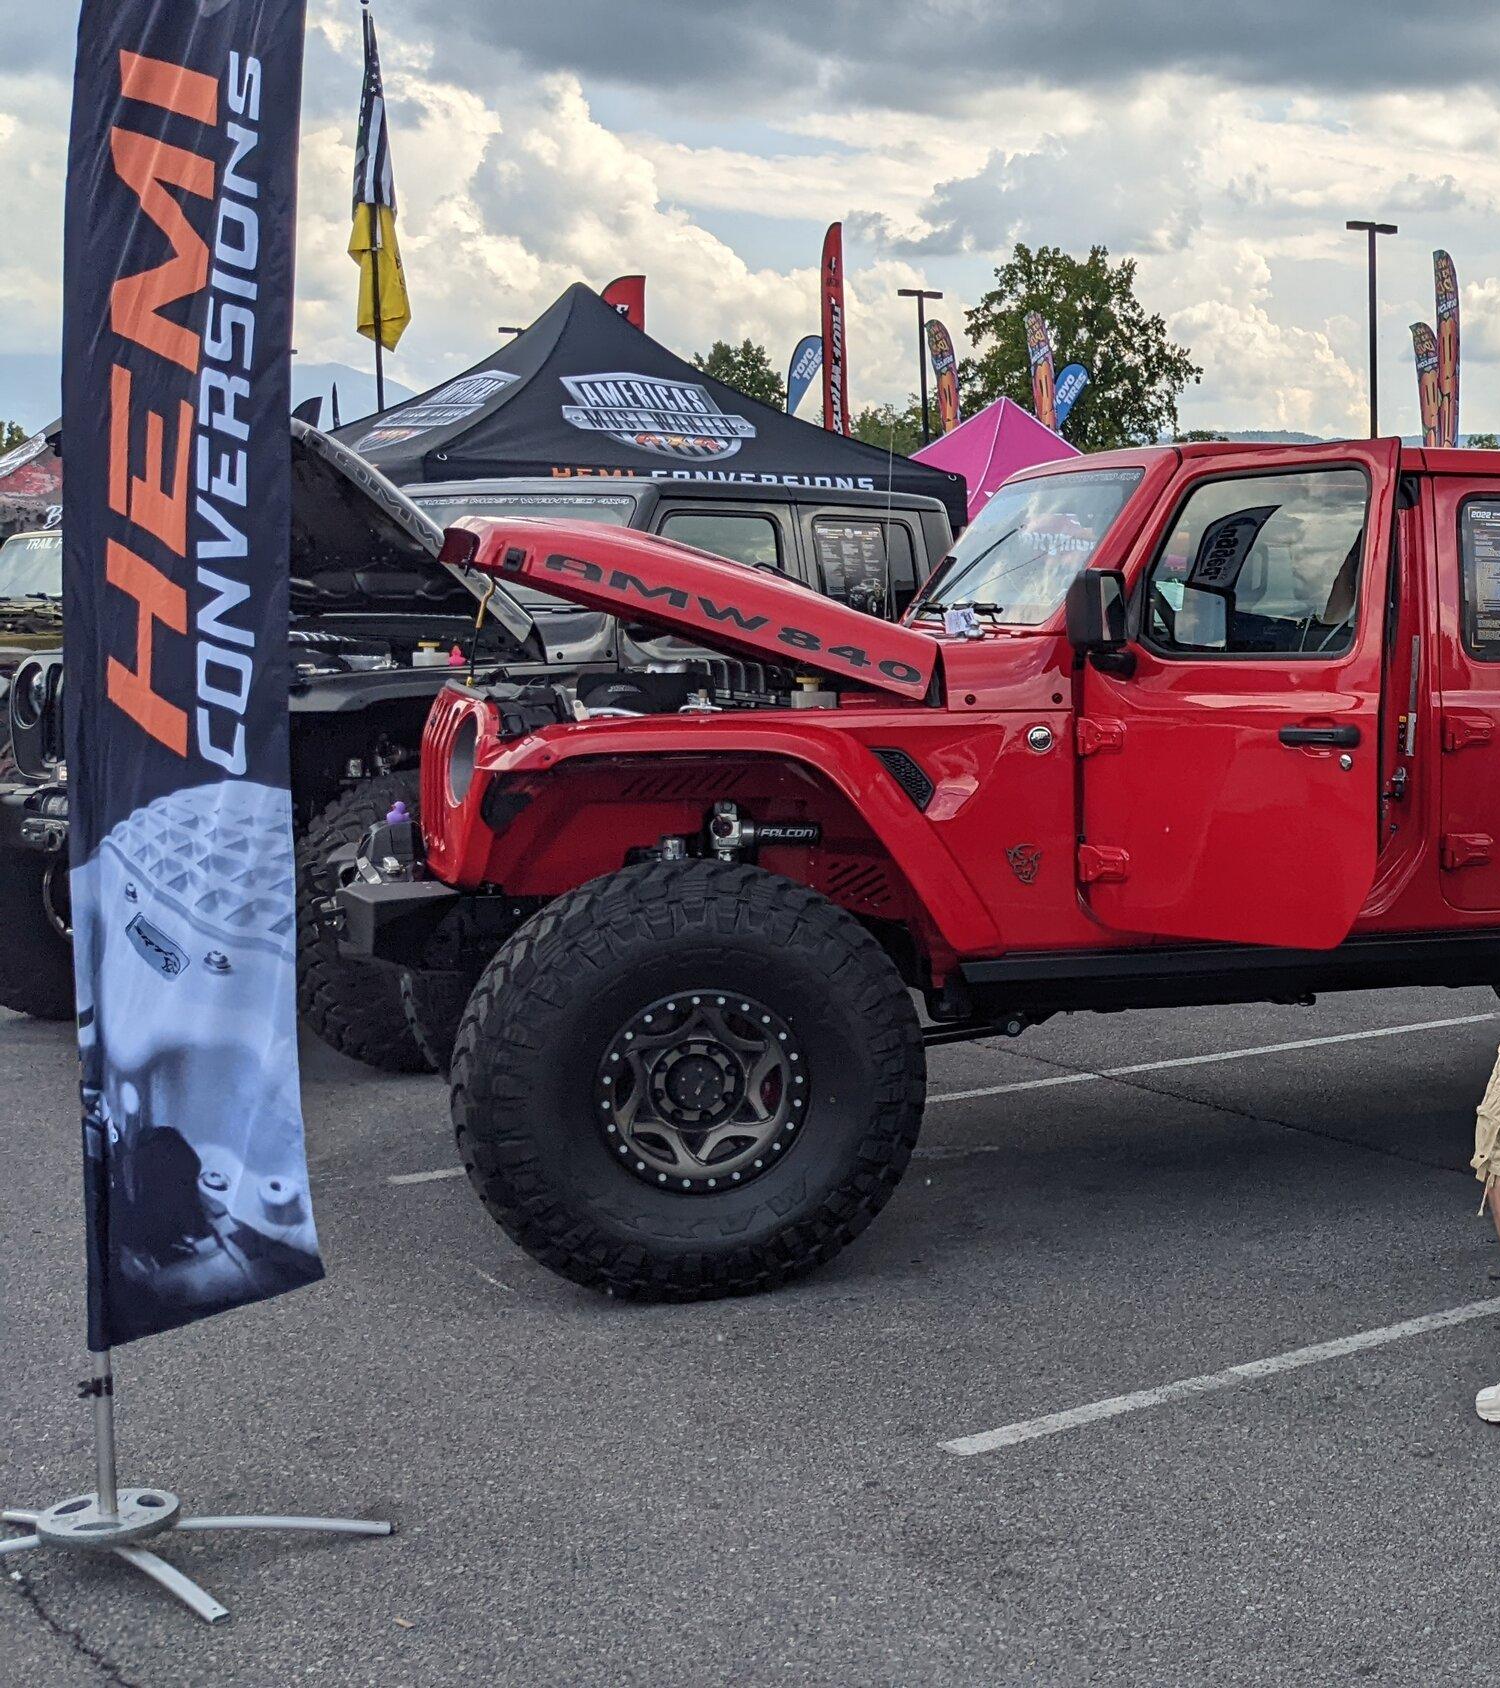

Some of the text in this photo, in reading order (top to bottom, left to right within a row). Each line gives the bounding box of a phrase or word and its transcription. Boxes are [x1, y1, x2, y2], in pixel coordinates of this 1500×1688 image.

[792, 347, 815, 381] TOYO
[106, 49, 219, 758] HEMI
[581, 380, 708, 413] AMERICAS
[197, 51, 262, 775] CONVERSIONS
[585, 409, 738, 436] MOST WANTED
[521, 497, 595, 505] WANTED
[26, 538, 53, 550] TRAIL
[760, 826, 815, 839] FALCON
